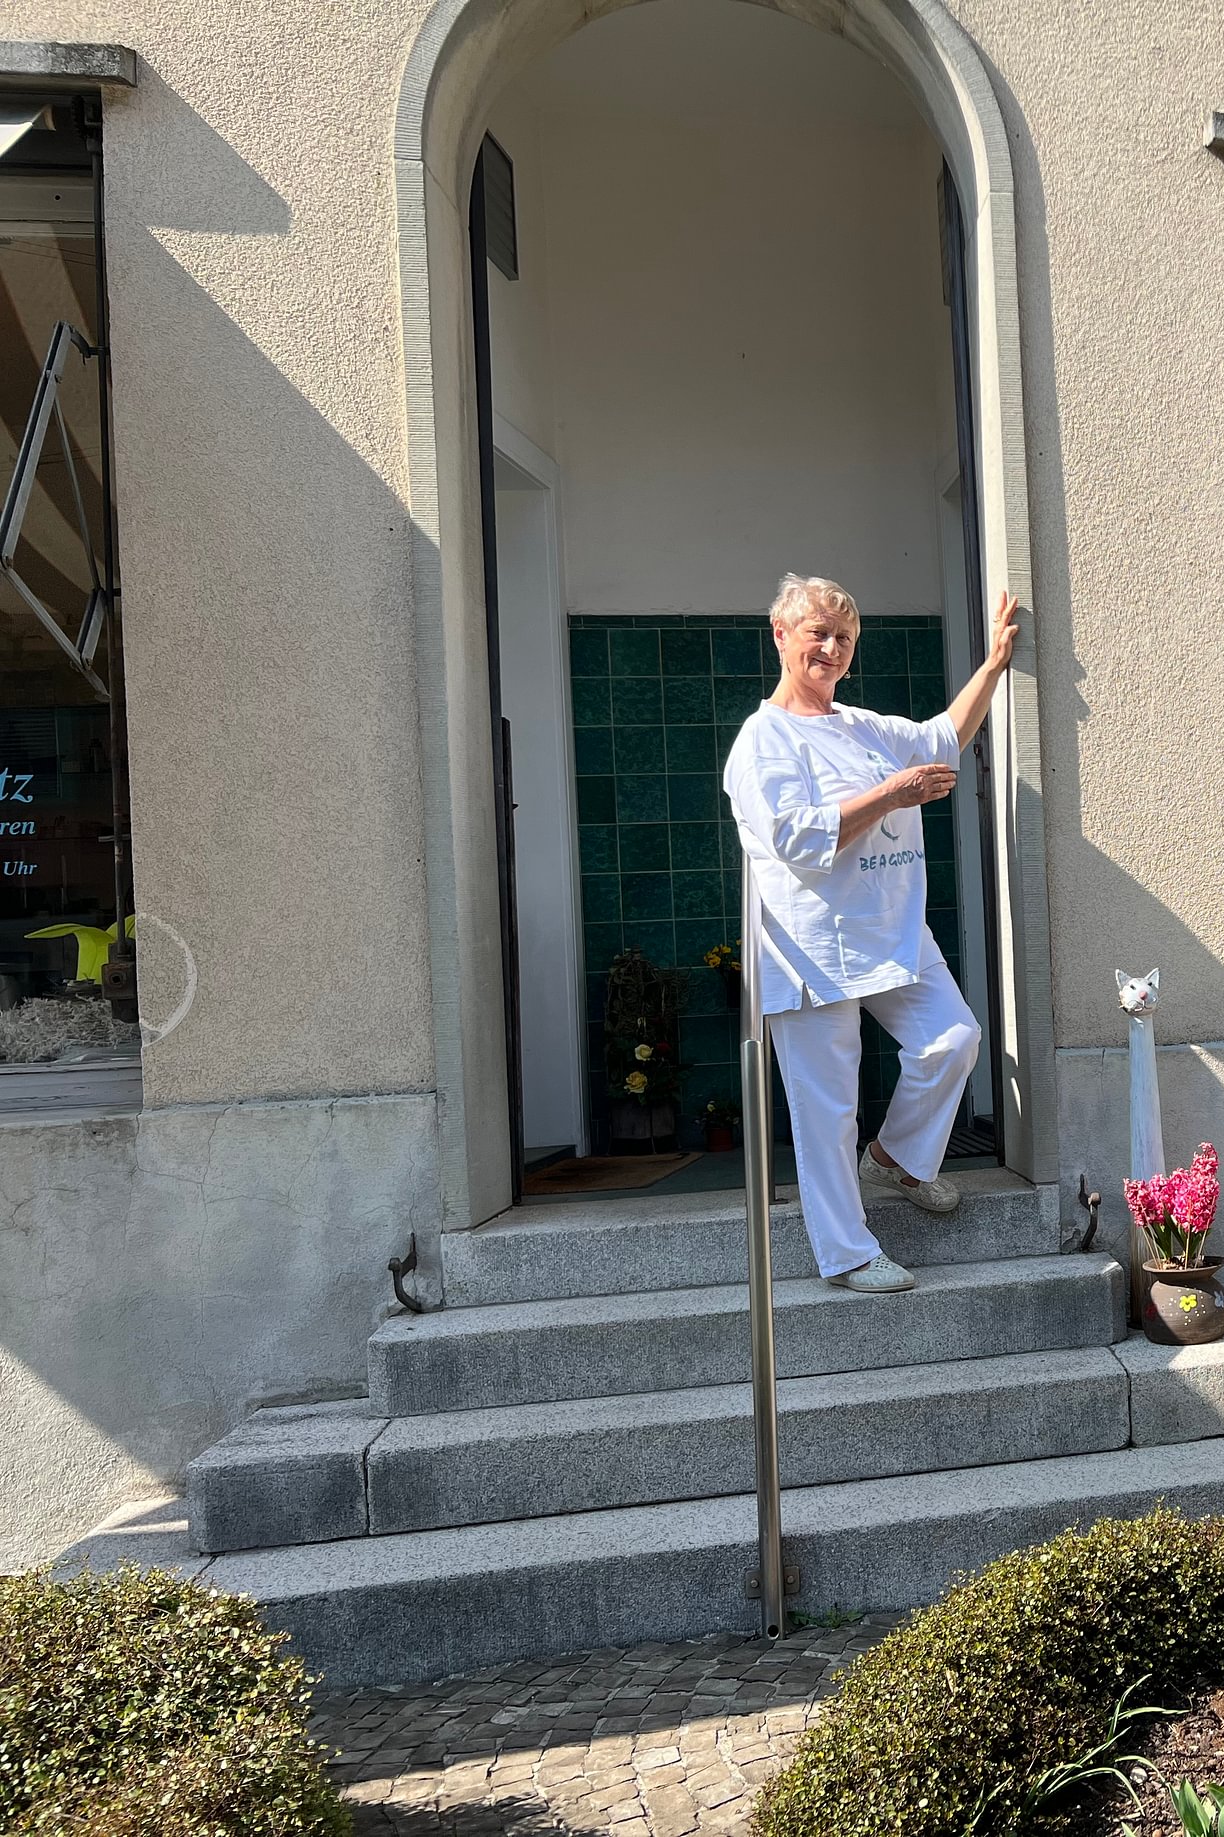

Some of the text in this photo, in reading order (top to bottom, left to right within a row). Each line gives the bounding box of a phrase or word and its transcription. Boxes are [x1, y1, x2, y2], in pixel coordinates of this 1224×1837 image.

[3, 861, 38, 876] Uhr
[859, 855, 877, 872] BE
[879, 853, 887, 868] A
[888, 850, 915, 867] GOOD
